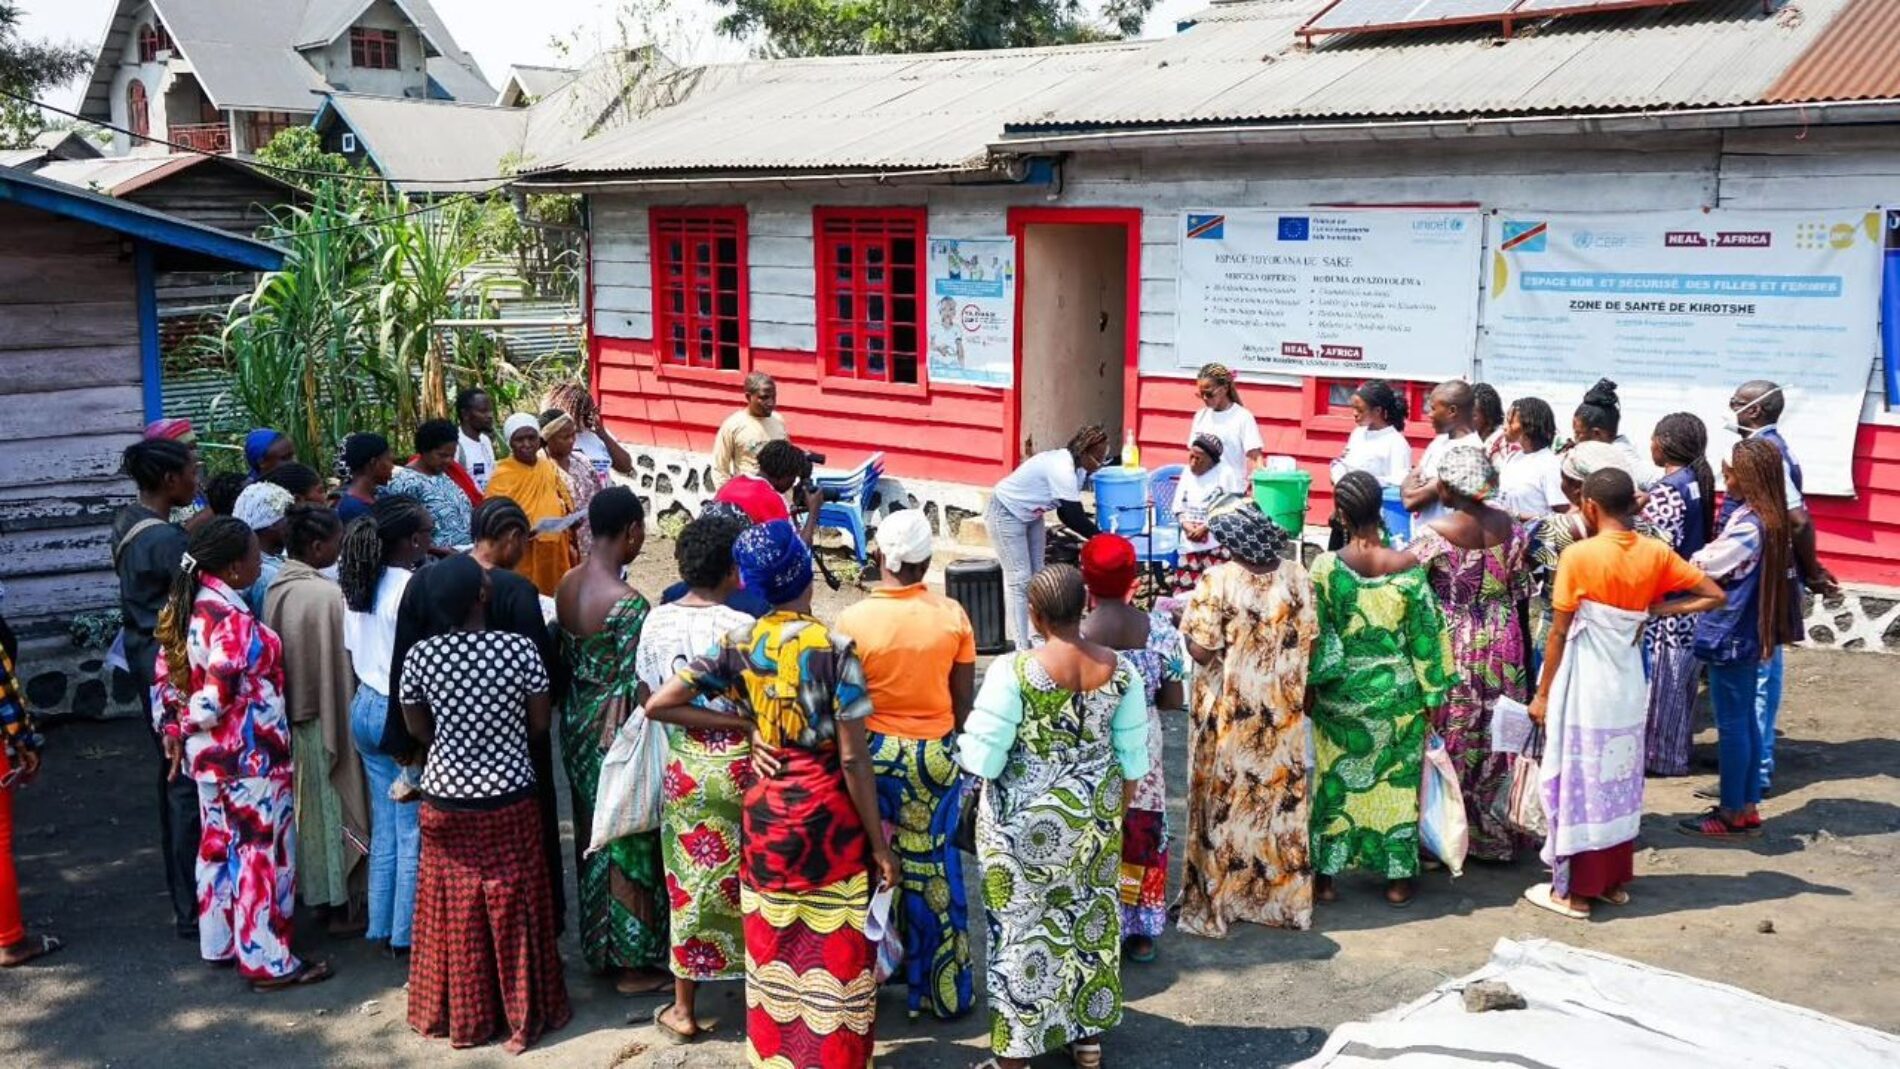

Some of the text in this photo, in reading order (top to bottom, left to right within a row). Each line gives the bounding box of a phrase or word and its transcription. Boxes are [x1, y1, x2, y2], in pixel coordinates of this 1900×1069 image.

[1412, 217, 1447, 231] unicef
[1668, 234, 1768, 245] HEAL AFRICA
[1322, 256, 1353, 268] SAKE
[1523, 276, 1567, 287] ESPACE
[1600, 278, 1615, 288] ET
[1619, 275, 1680, 290] SÉCURISÉ
[1686, 279, 1711, 290] DES
[1713, 280, 1758, 292] FILLES
[1760, 281, 1776, 292] ET
[1569, 299, 1757, 315] ZONE DE SANTÉ DE KIROTSHE
[1284, 344, 1309, 355] HEAL
[1324, 346, 1361, 358] AFRICA
